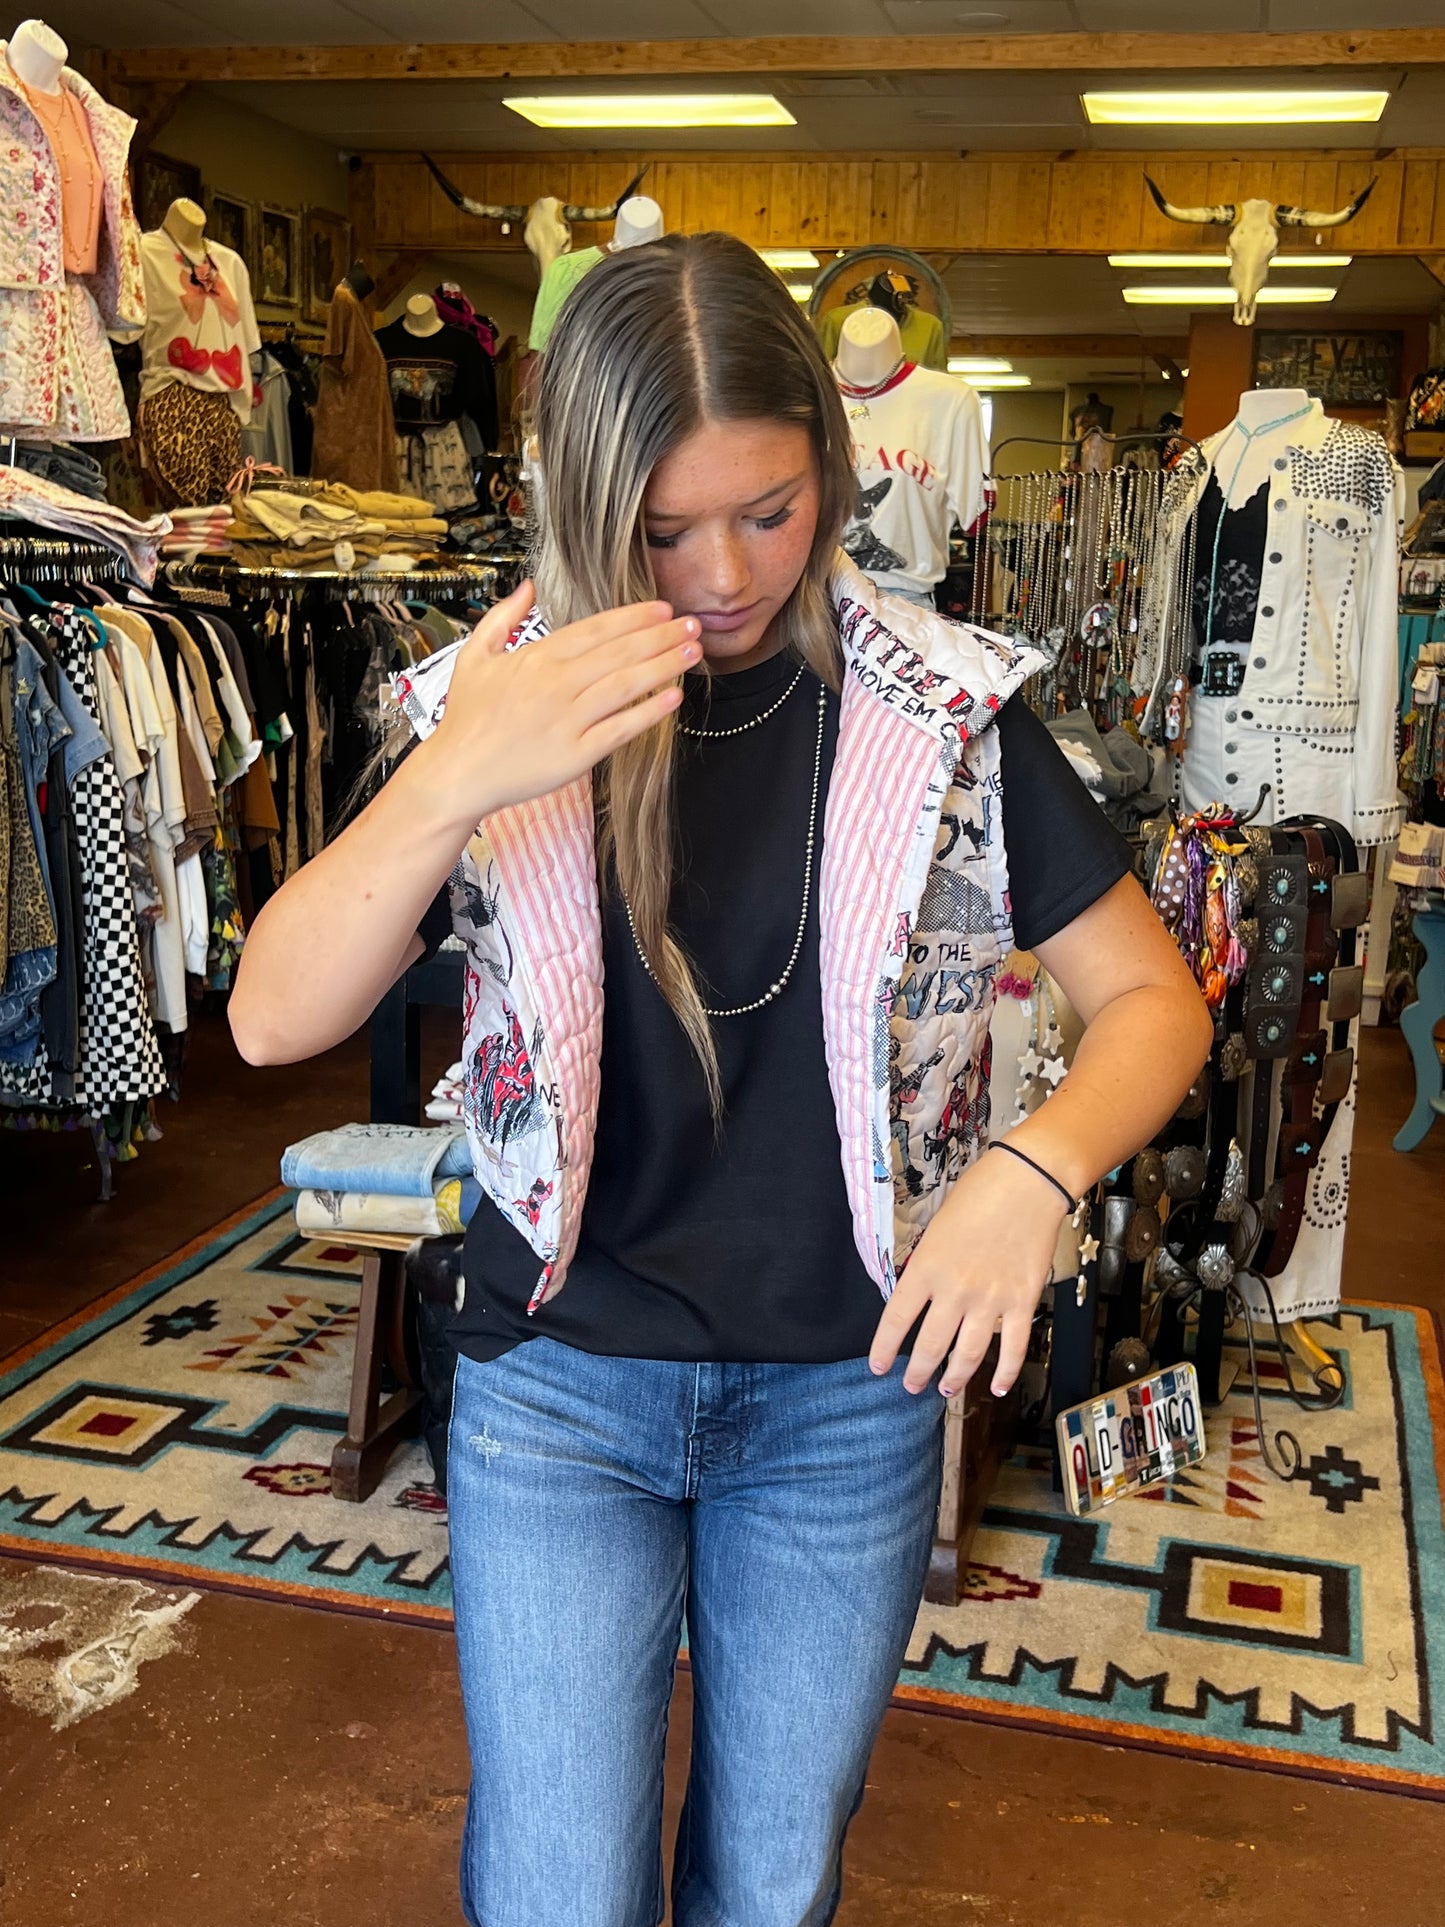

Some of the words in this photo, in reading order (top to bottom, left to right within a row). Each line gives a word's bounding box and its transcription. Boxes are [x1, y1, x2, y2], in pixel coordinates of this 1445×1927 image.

[850, 658, 906, 704] MOVE
[901, 697, 937, 727] EM
[905, 943, 928, 964] TO
[938, 943, 972, 964] THE
[897, 964, 996, 1020] WEST
